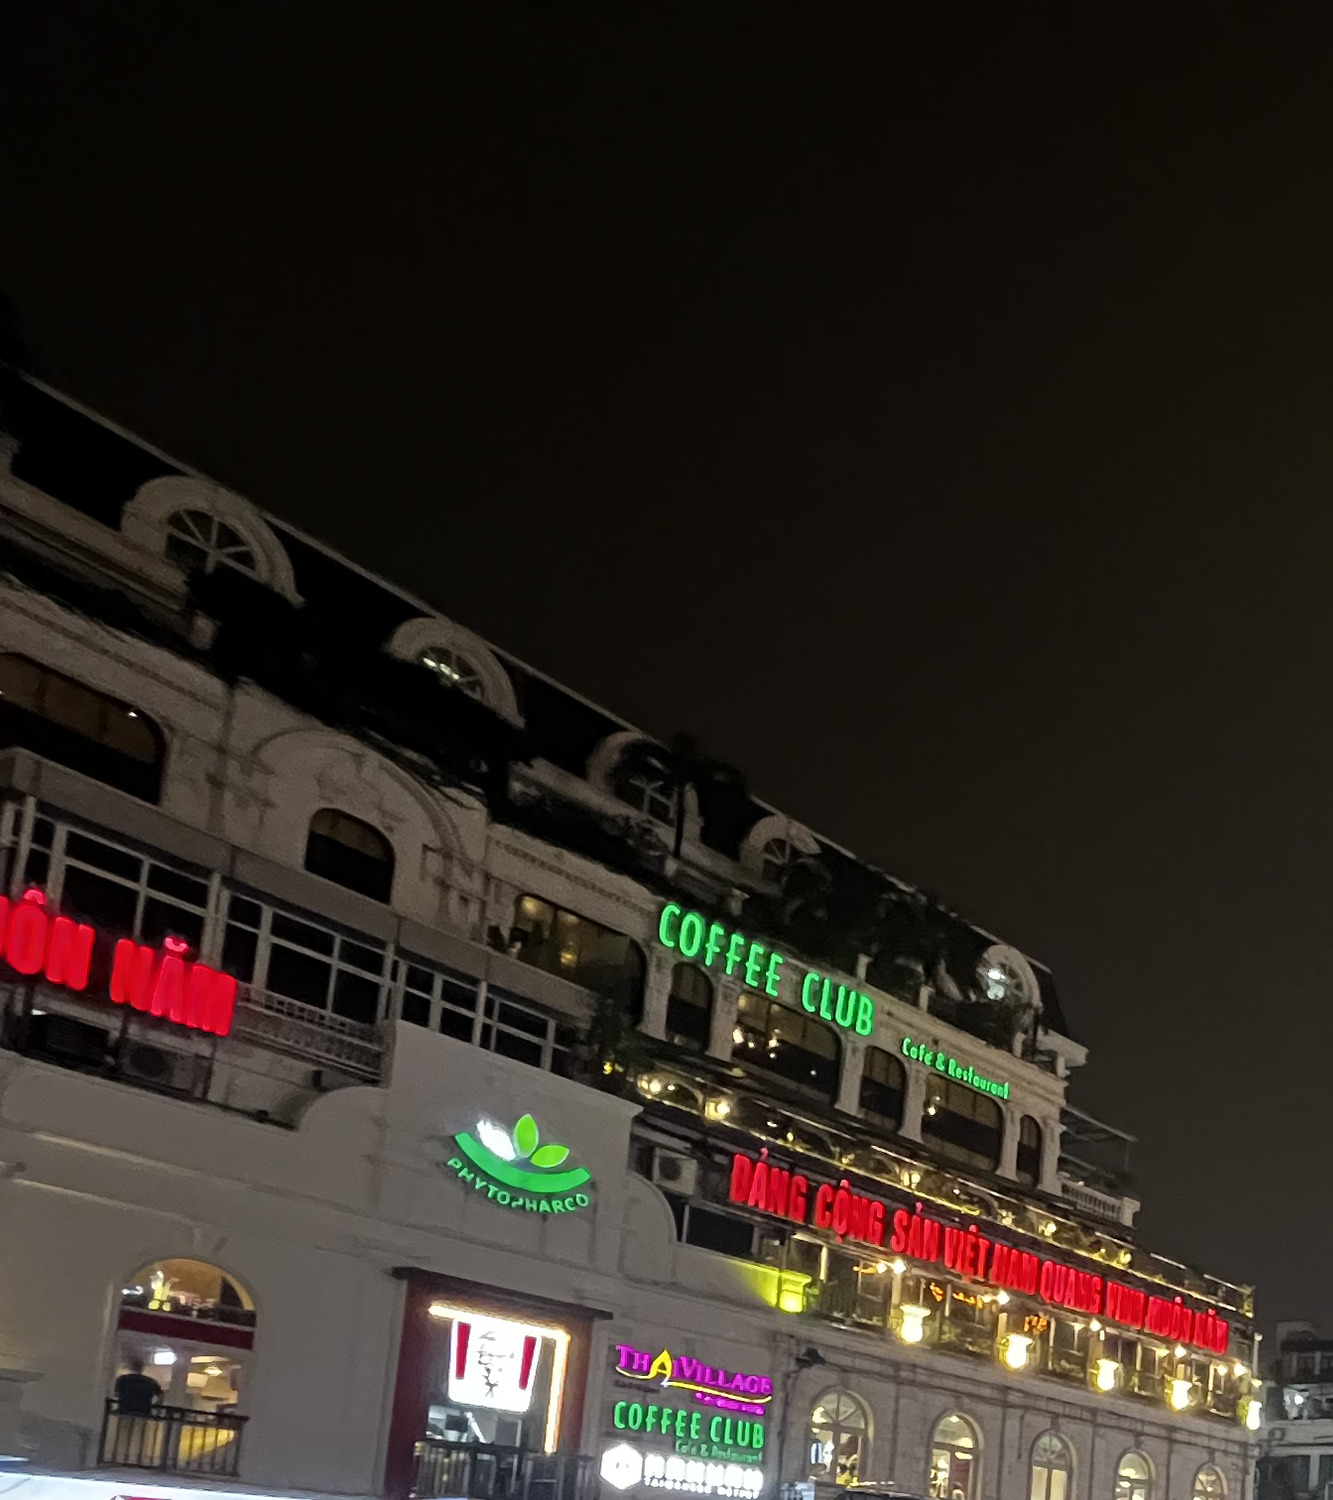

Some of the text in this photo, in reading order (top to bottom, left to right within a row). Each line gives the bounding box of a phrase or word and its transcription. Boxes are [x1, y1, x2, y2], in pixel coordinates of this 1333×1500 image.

[0, 886, 95, 991] ÔN
[658, 902, 875, 1036] COFFEE CLUB
[935, 1052, 946, 1072] &
[948, 1058, 1009, 1100] Restaurant
[446, 1157, 590, 1214] PHYTOPHARCO
[815, 1178, 886, 1246] CỘNG
[890, 1201, 942, 1263] SẢN
[944, 1223, 992, 1283] VIỆT
[1040, 1260, 1104, 1315] QUANG
[613, 1401, 702, 1440] COFFEE
[709, 1415, 765, 1449] CLUB
